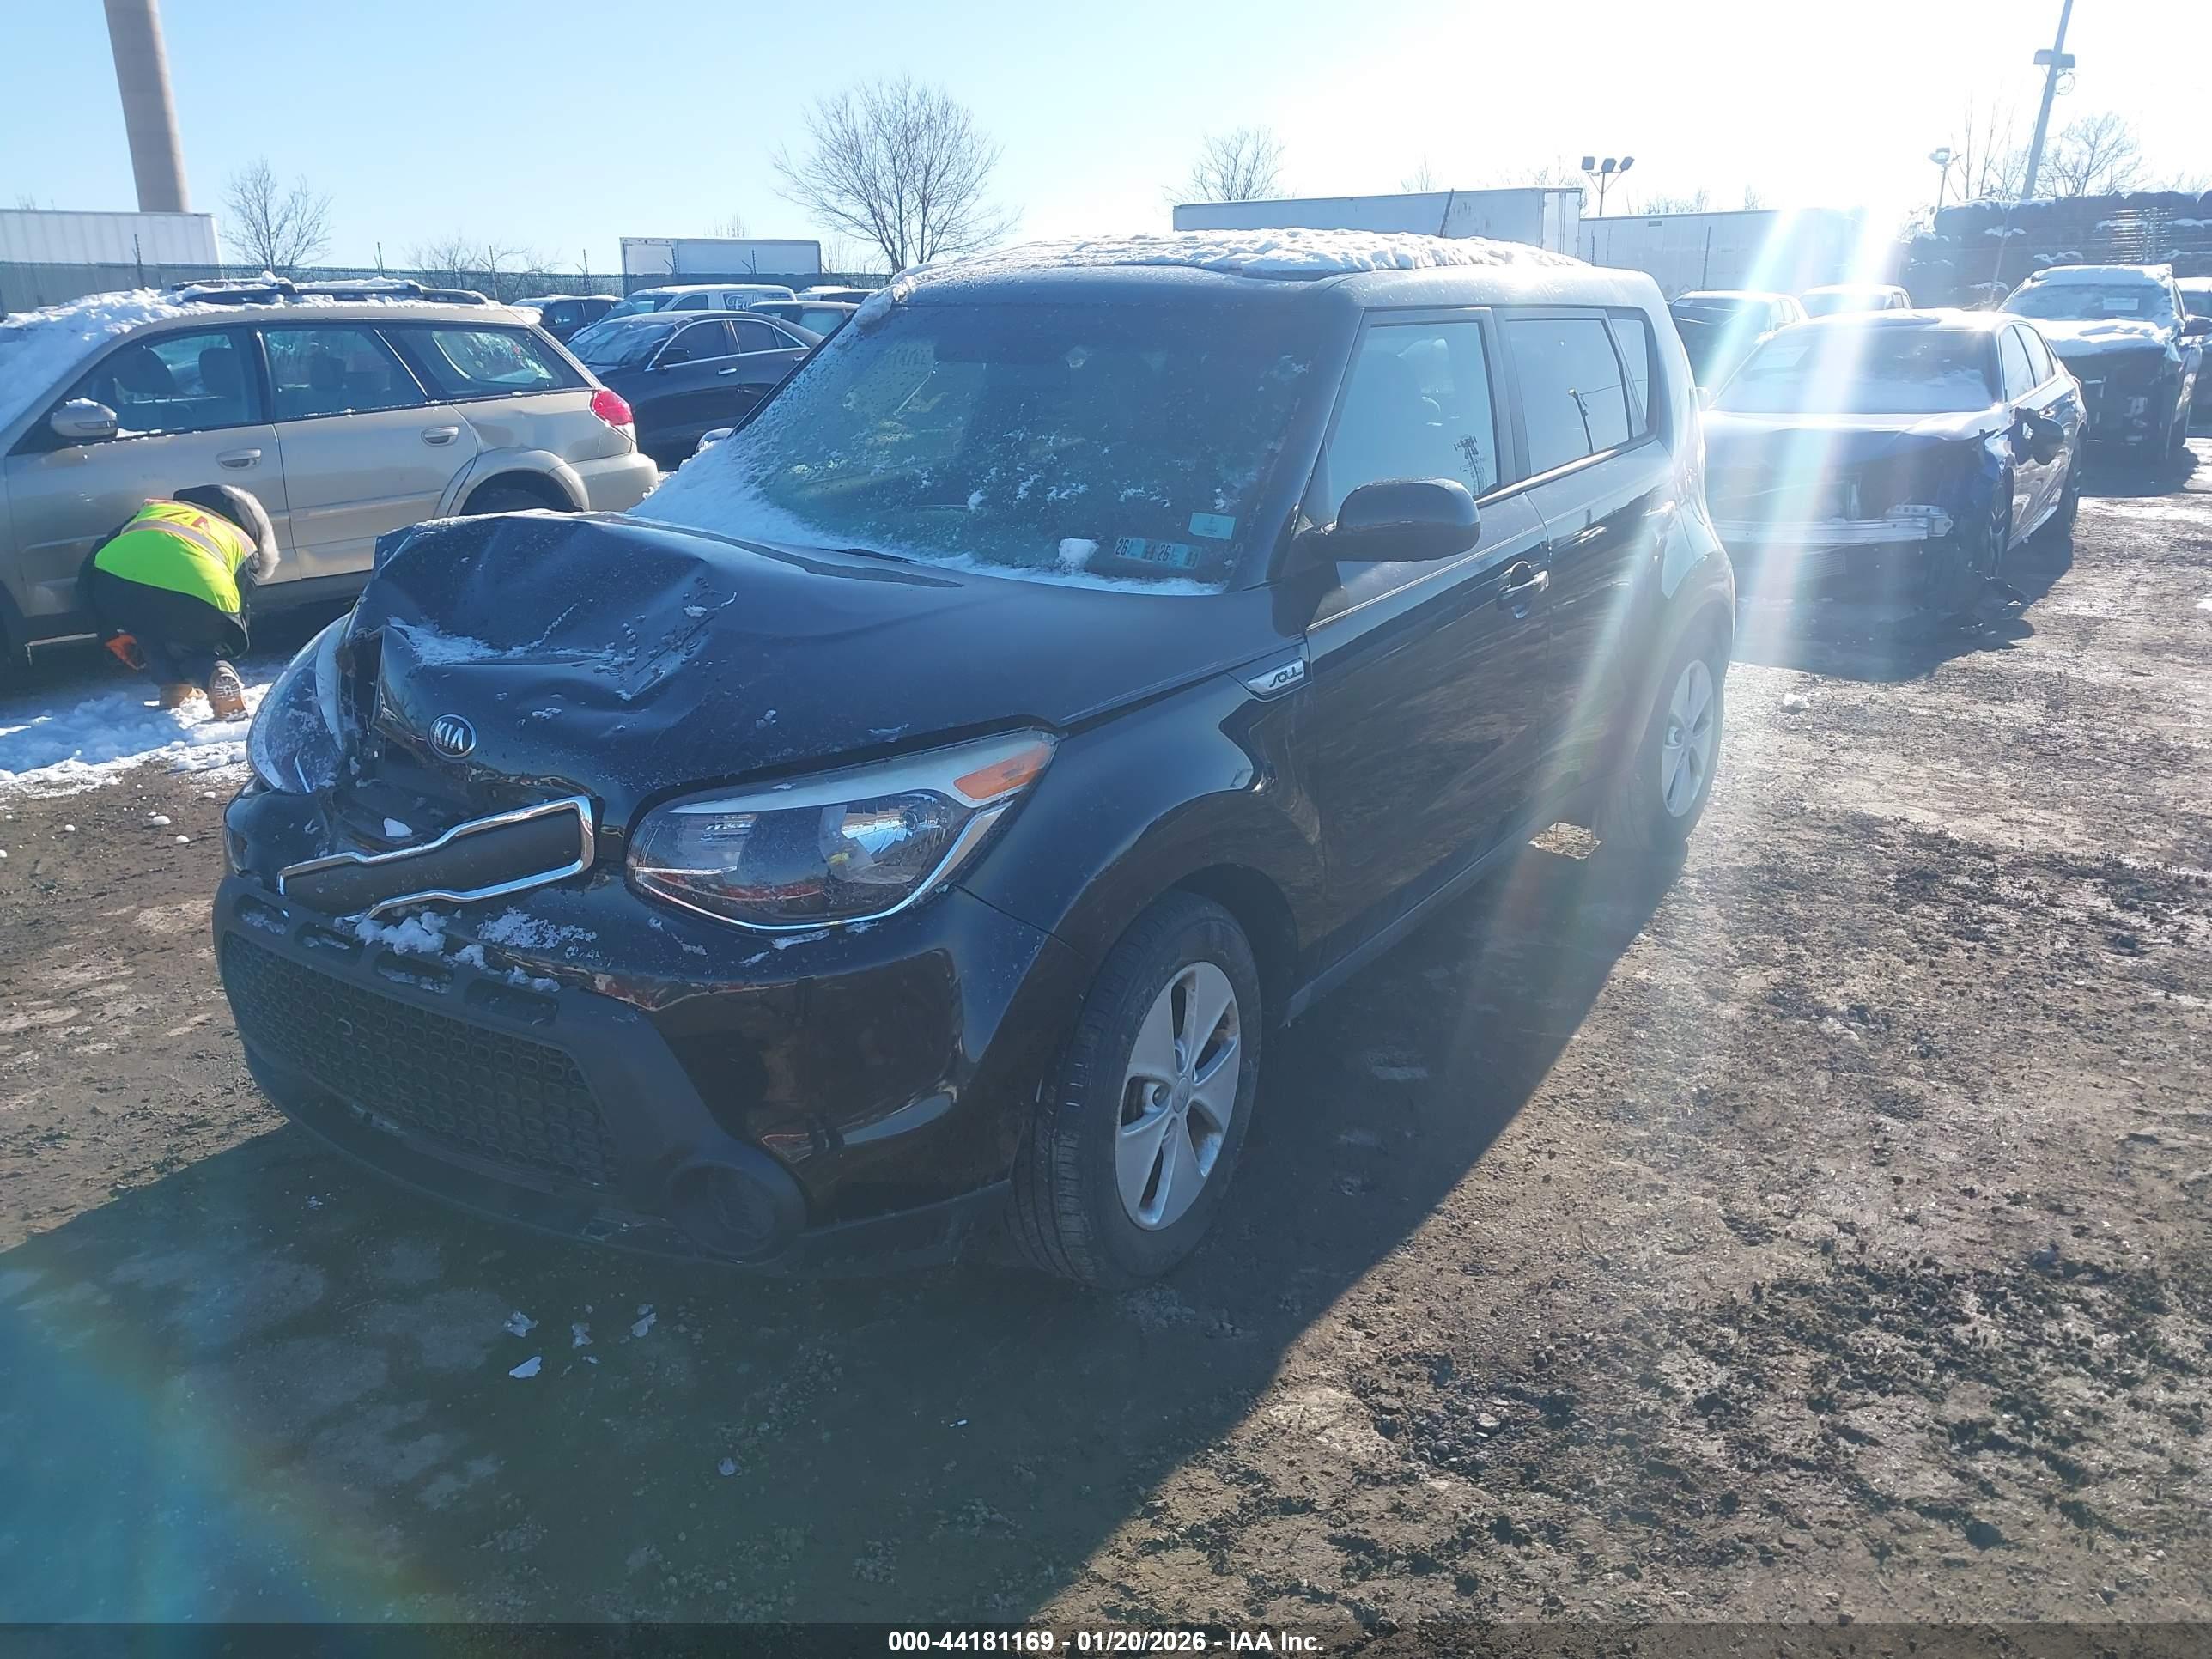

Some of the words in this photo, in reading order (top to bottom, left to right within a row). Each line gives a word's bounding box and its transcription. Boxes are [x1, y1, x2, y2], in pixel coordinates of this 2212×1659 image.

[1115, 538, 1130, 556] 26
[1158, 544, 1172, 562] 26
[1269, 666, 1304, 688] SOUL
[434, 721, 465, 751] KIA
